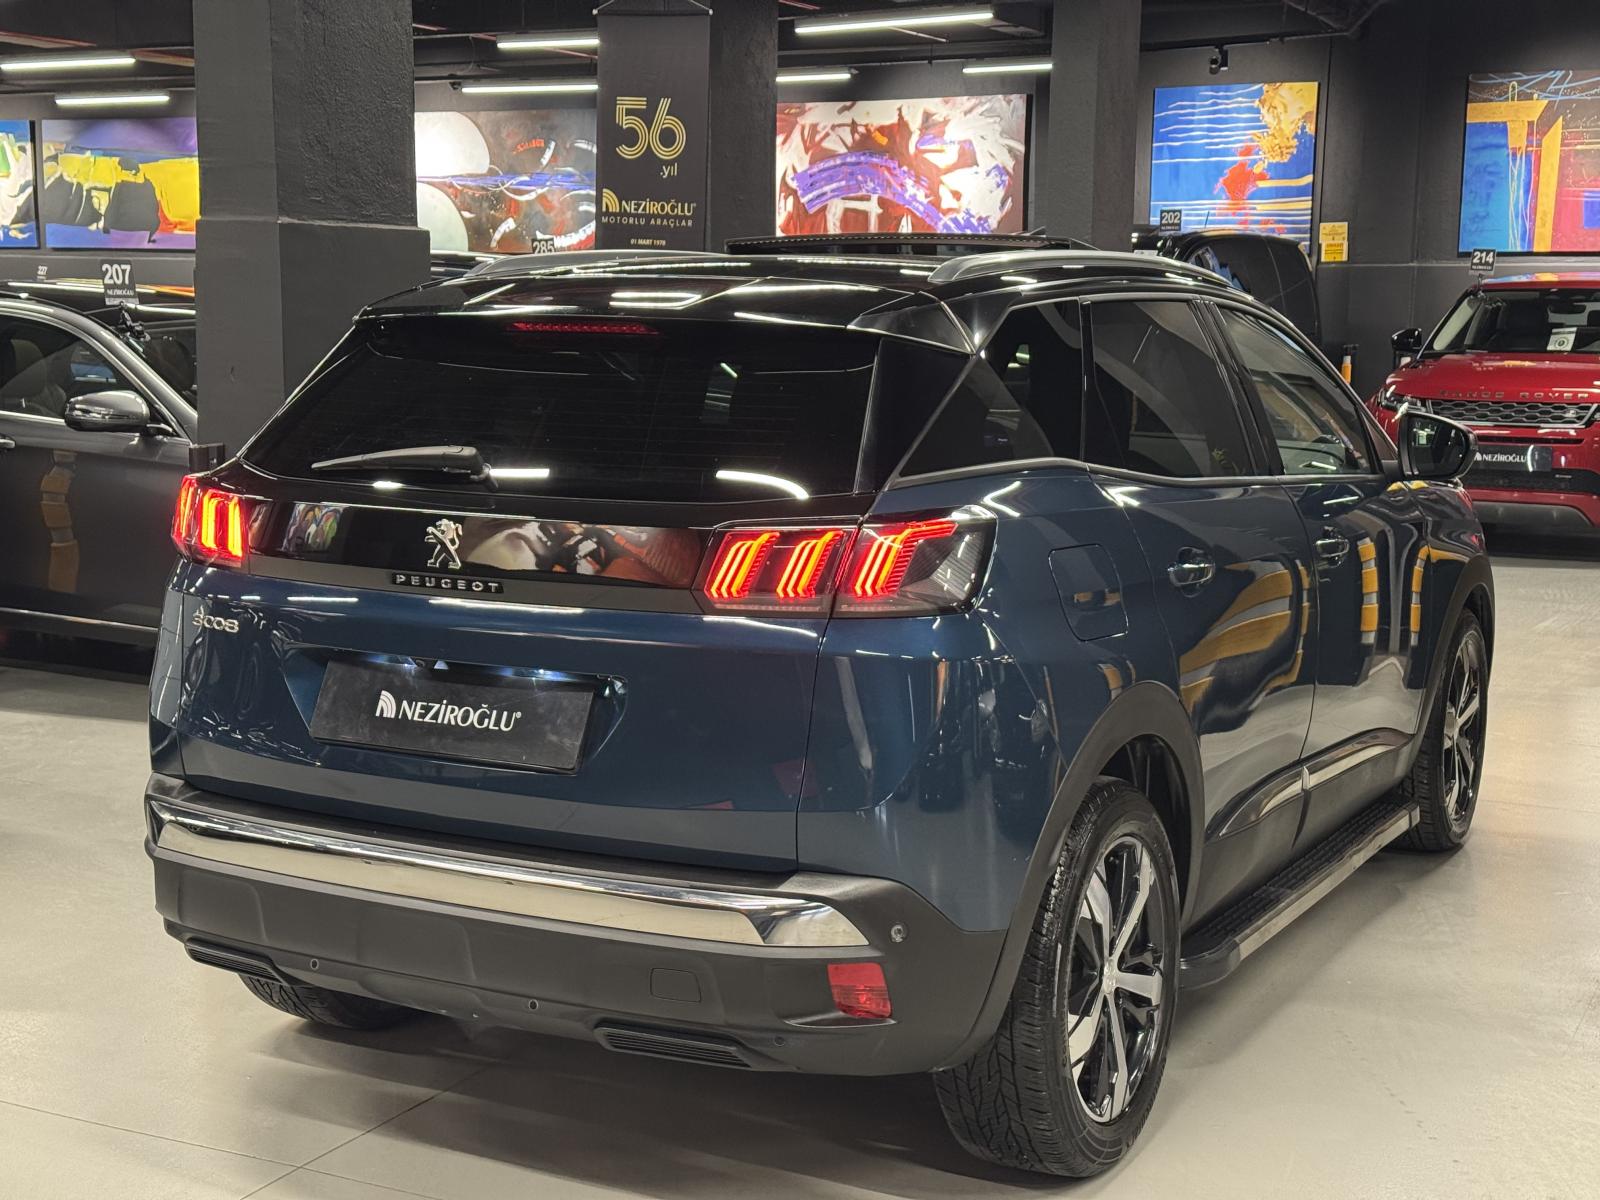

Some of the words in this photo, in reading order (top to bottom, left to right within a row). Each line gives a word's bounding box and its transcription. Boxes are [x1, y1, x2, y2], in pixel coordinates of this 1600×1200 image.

[616, 97, 686, 159] 56
[621, 198, 694, 216] NEZİROĞLU
[602, 216, 645, 225] MOTORLU
[650, 217, 693, 228] ARAÇLAR
[1161, 212, 1181, 224] 202
[533, 241, 555, 254] 285
[1472, 251, 1494, 264] 214
[102, 264, 131, 284] 207
[1520, 392, 1589, 400] ROVER
[1482, 451, 1527, 463] NEZİROĞLU
[396, 574, 500, 593] PEUGEOT
[192, 613, 240, 633] 3008
[399, 700, 516, 731] NEZİROĞLU
